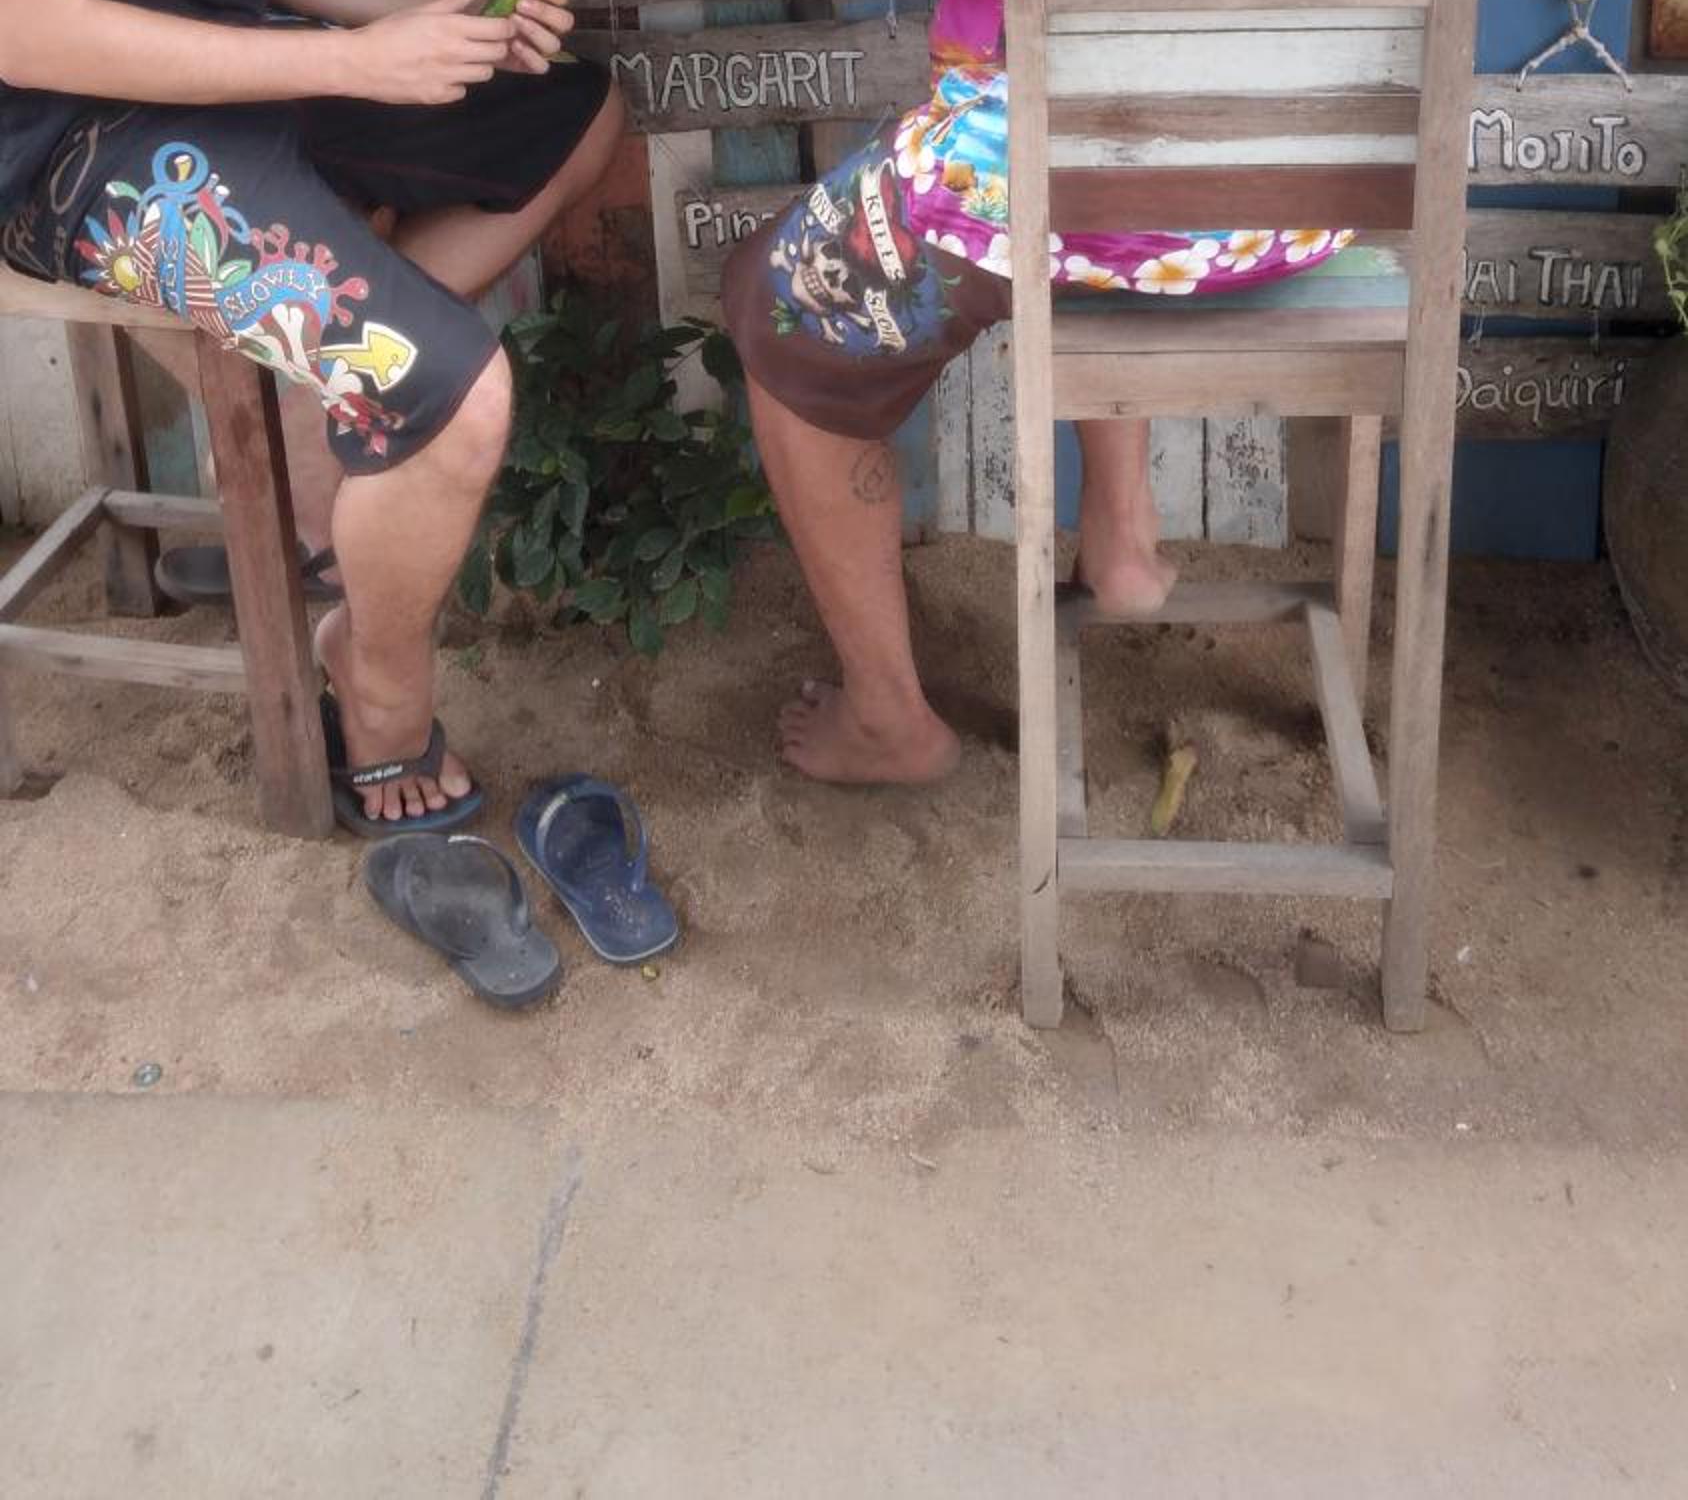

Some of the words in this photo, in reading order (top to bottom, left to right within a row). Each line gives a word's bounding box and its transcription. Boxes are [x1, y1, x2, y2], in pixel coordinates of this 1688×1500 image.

[610, 50, 865, 114] MARGARIT
[685, 203, 776, 248] Pin
[1529, 250, 1643, 306] THAI
